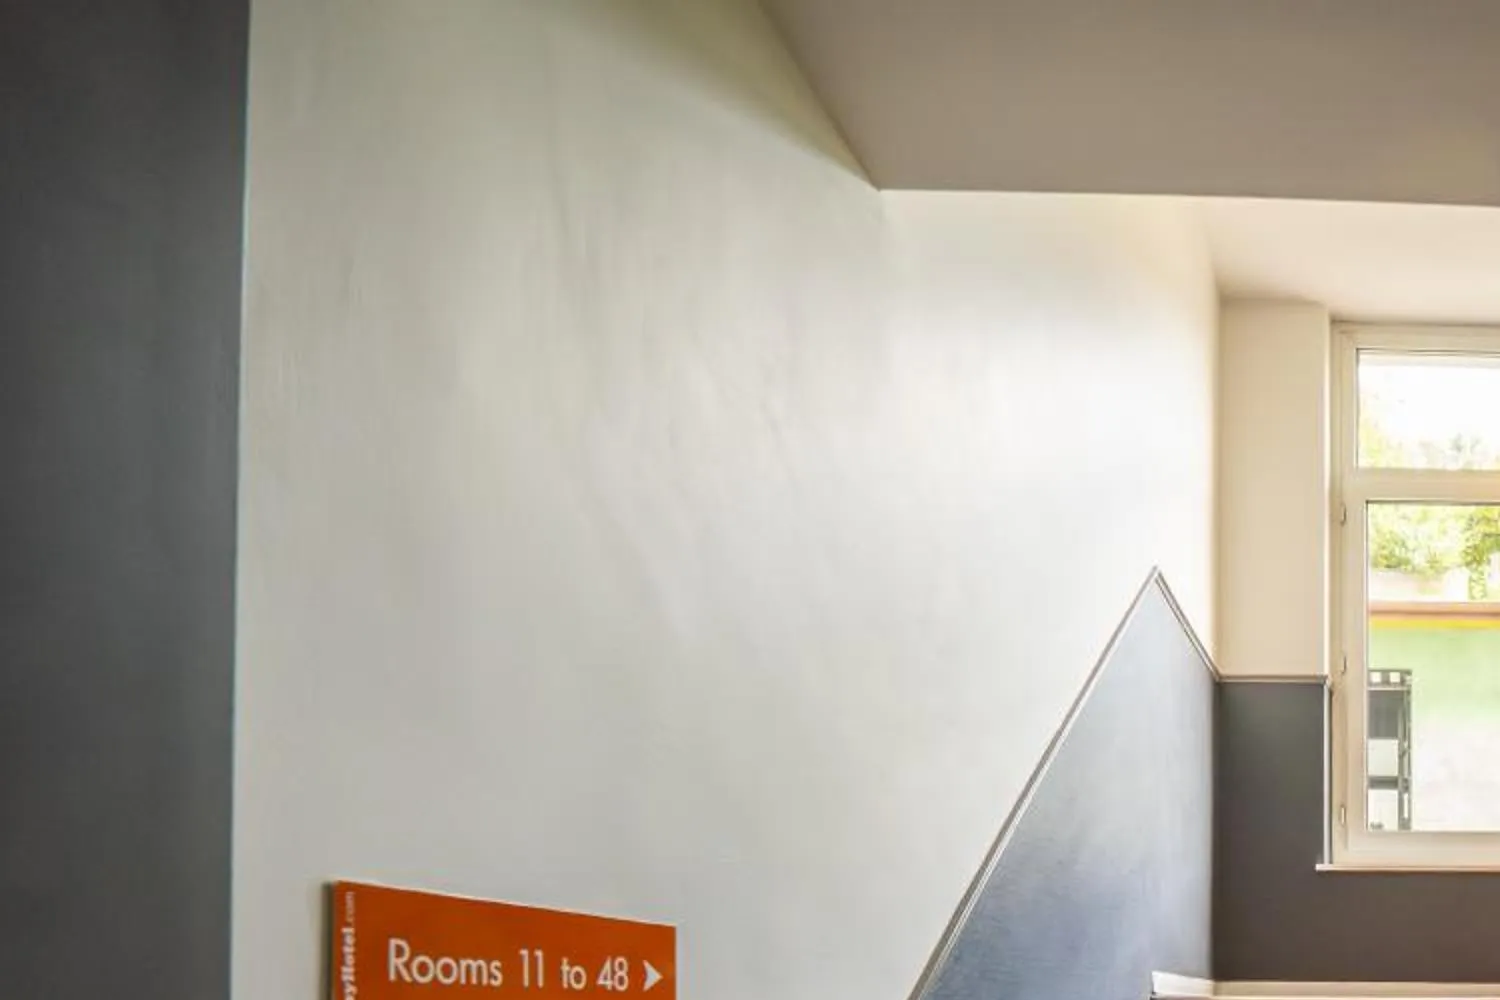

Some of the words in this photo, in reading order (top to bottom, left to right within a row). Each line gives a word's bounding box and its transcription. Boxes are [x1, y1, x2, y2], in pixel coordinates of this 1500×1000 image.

[387, 938, 503, 987] Rooms
[519, 948, 545, 988] 11
[560, 957, 587, 991] to
[595, 956, 630, 992] 48
